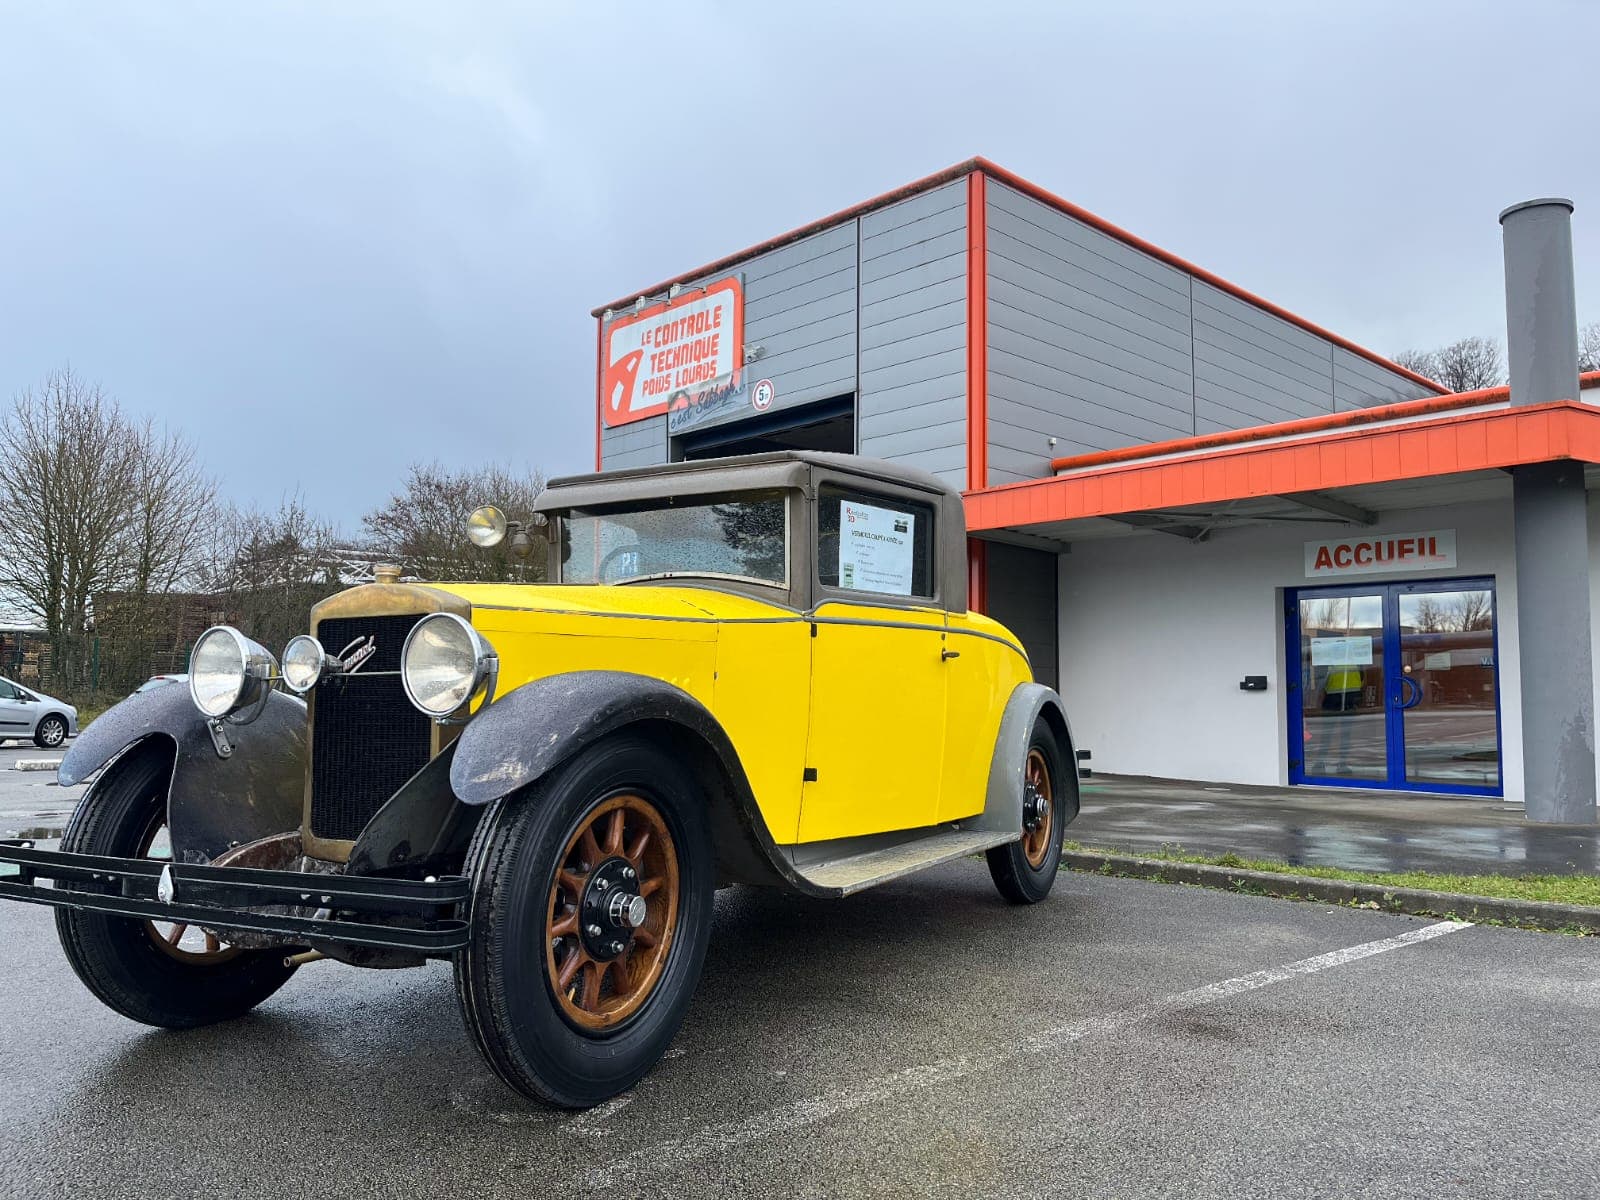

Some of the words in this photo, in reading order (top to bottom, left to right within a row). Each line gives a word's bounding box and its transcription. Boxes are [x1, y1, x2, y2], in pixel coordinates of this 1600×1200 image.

[641, 329, 652, 346] LE
[654, 305, 722, 348] CONTROLE
[650, 333, 720, 375] TECHNIQUE
[642, 373, 671, 397] POIDS
[675, 360, 717, 388] LOURDS
[1314, 536, 1447, 570] ACCUEIL
